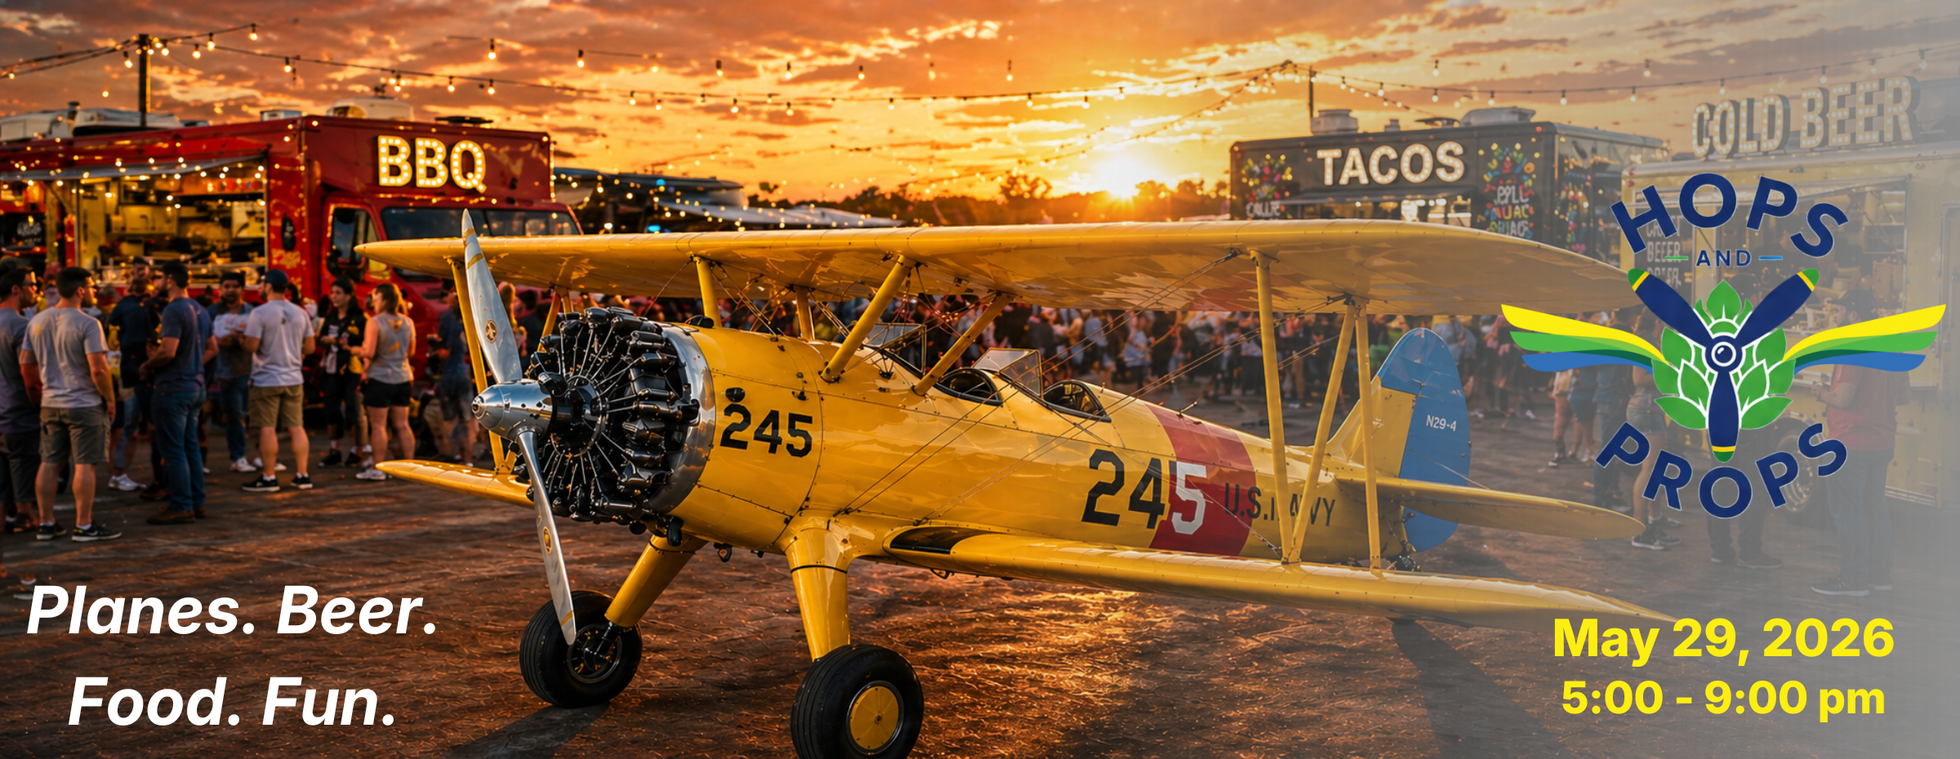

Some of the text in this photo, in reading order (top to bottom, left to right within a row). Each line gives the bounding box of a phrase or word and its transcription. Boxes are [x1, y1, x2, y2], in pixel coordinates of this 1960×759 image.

[1692, 76, 1914, 158] COLD BEER
[378, 135, 487, 193] BBQ
[1316, 141, 1465, 185] TACOS
[720, 403, 813, 458] 245
[1426, 414, 1457, 432] N29-4
[1081, 448, 1207, 535] 245
